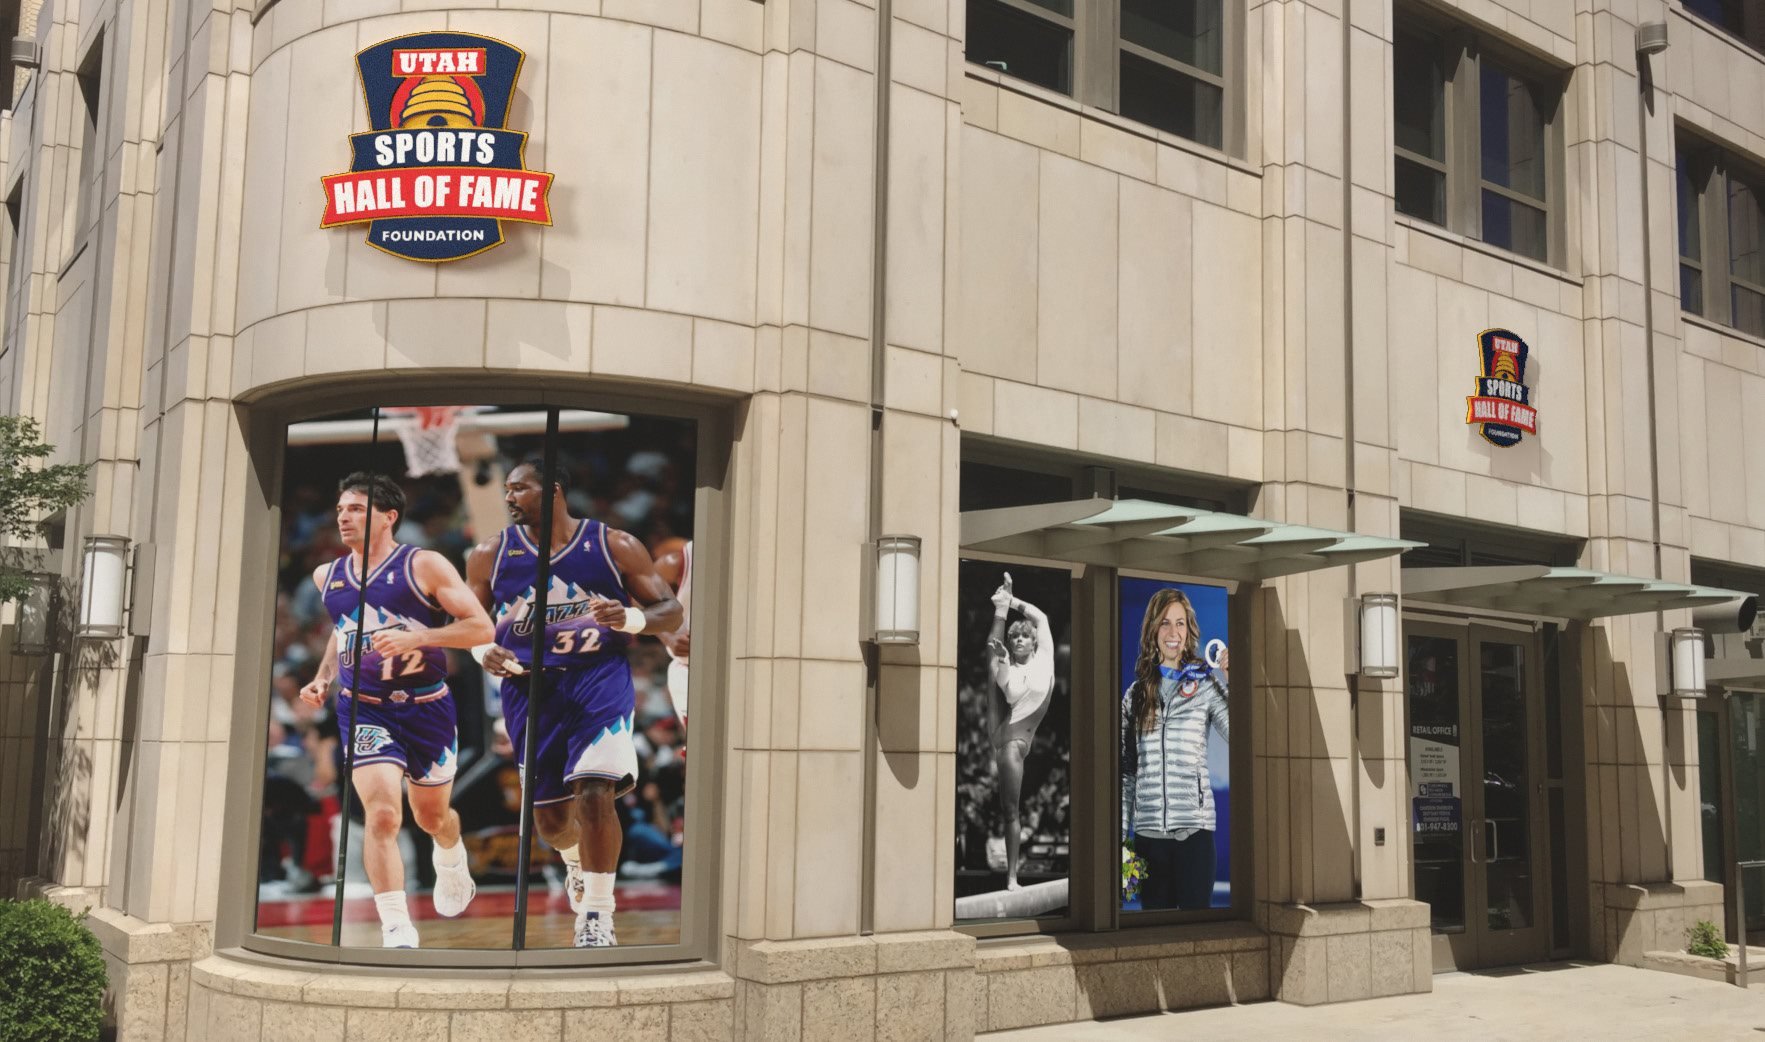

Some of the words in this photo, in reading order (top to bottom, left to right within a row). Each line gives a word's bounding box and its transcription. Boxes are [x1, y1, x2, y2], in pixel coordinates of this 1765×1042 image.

[400, 52, 478, 74] UTAH
[375, 131, 495, 166] SPORTS
[334, 179, 406, 215] HALL
[414, 175, 451, 208] OF
[459, 176, 540, 212] FAME
[382, 229, 485, 242] FOUNDATION
[1494, 338, 1518, 353] UTAH
[1487, 379, 1522, 401] SPORTS
[1474, 400, 1496, 418] HALL
[1498, 402, 1509, 420] OF
[1511, 404, 1534, 428] FAME
[1488, 428, 1519, 440] FOUNDATION
[552, 628, 602, 654] 32
[378, 650, 427, 681] 12
[1412, 725, 1432, 735] RETAIL
[1432, 725, 1452, 735] OFFICE
